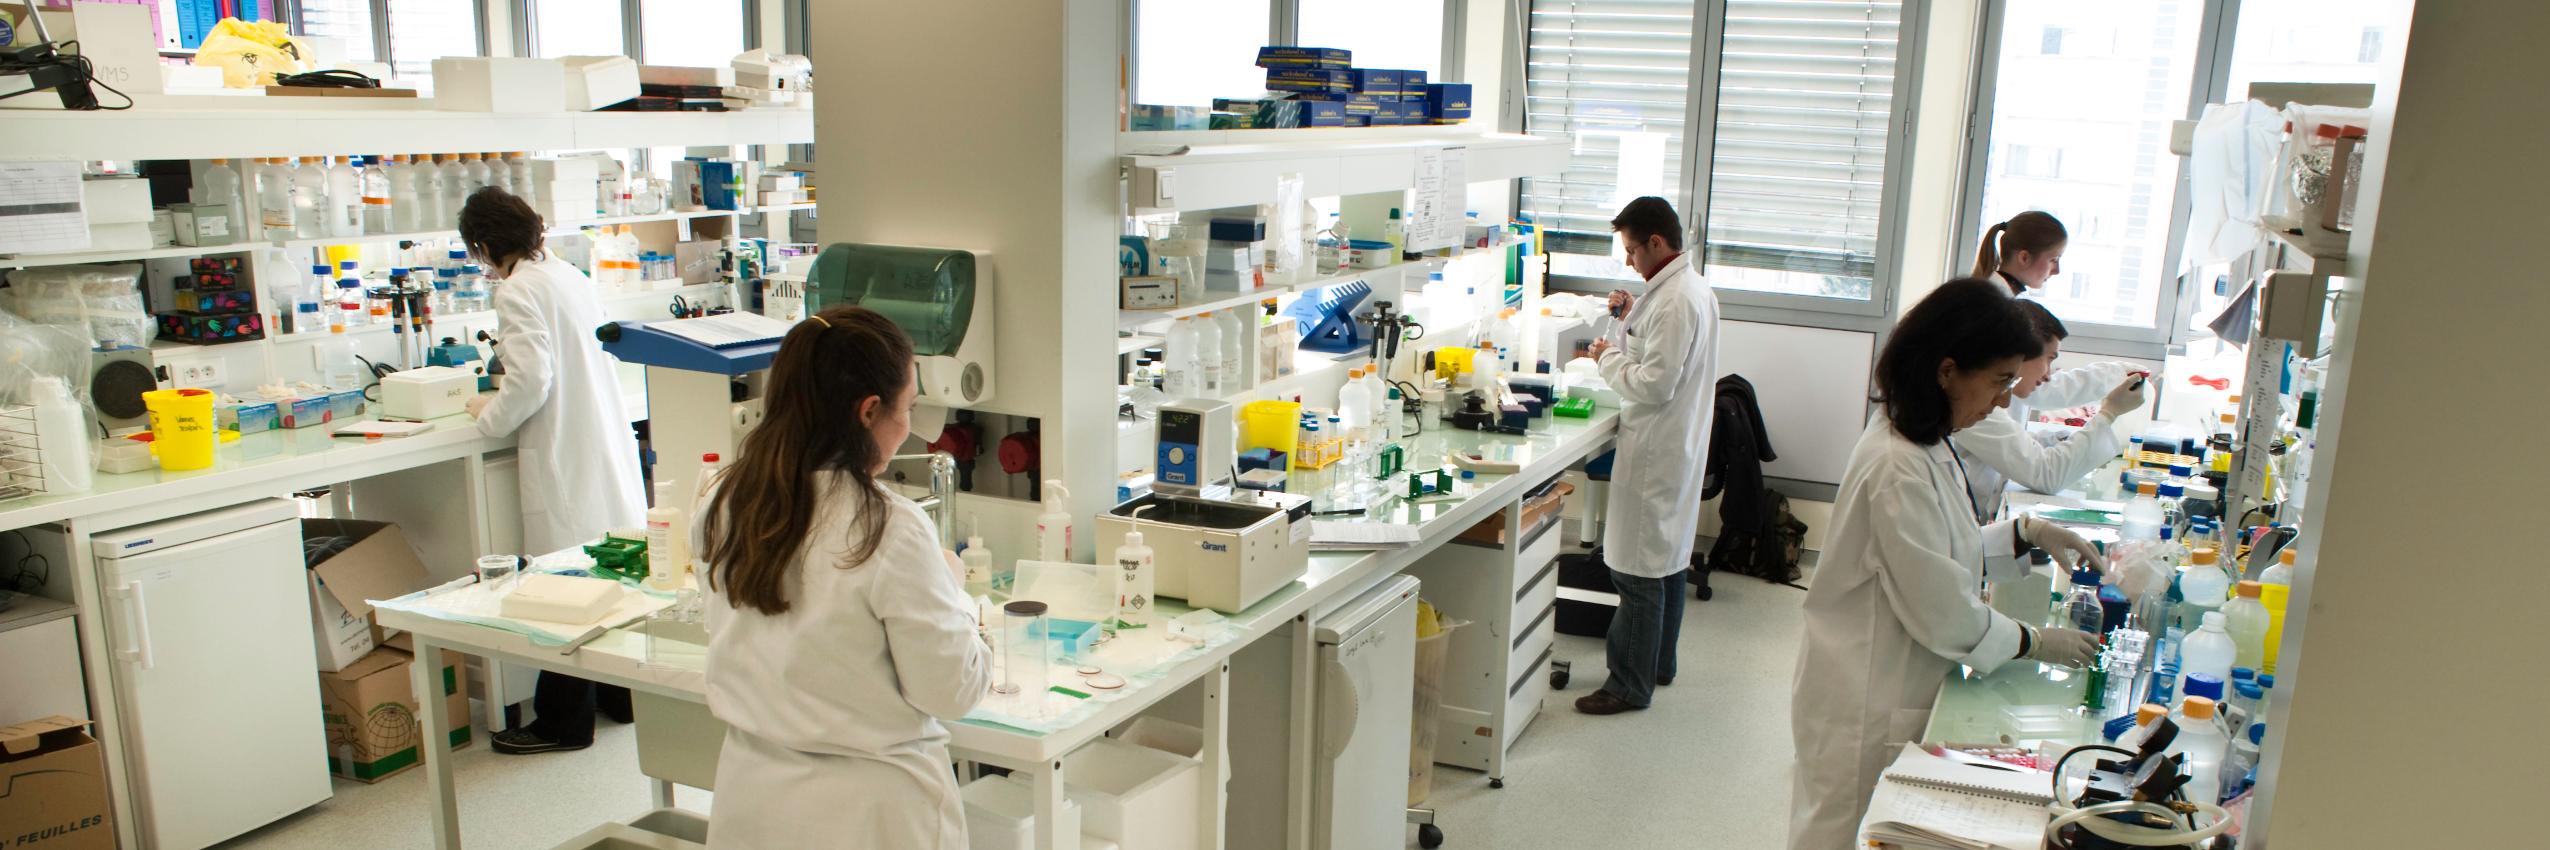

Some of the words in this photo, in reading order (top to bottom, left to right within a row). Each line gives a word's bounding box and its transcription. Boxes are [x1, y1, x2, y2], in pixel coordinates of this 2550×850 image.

[1167, 473, 1185, 481] Grant
[1201, 540, 1228, 553] Grant
[16, 814, 103, 847] FEUILLES
